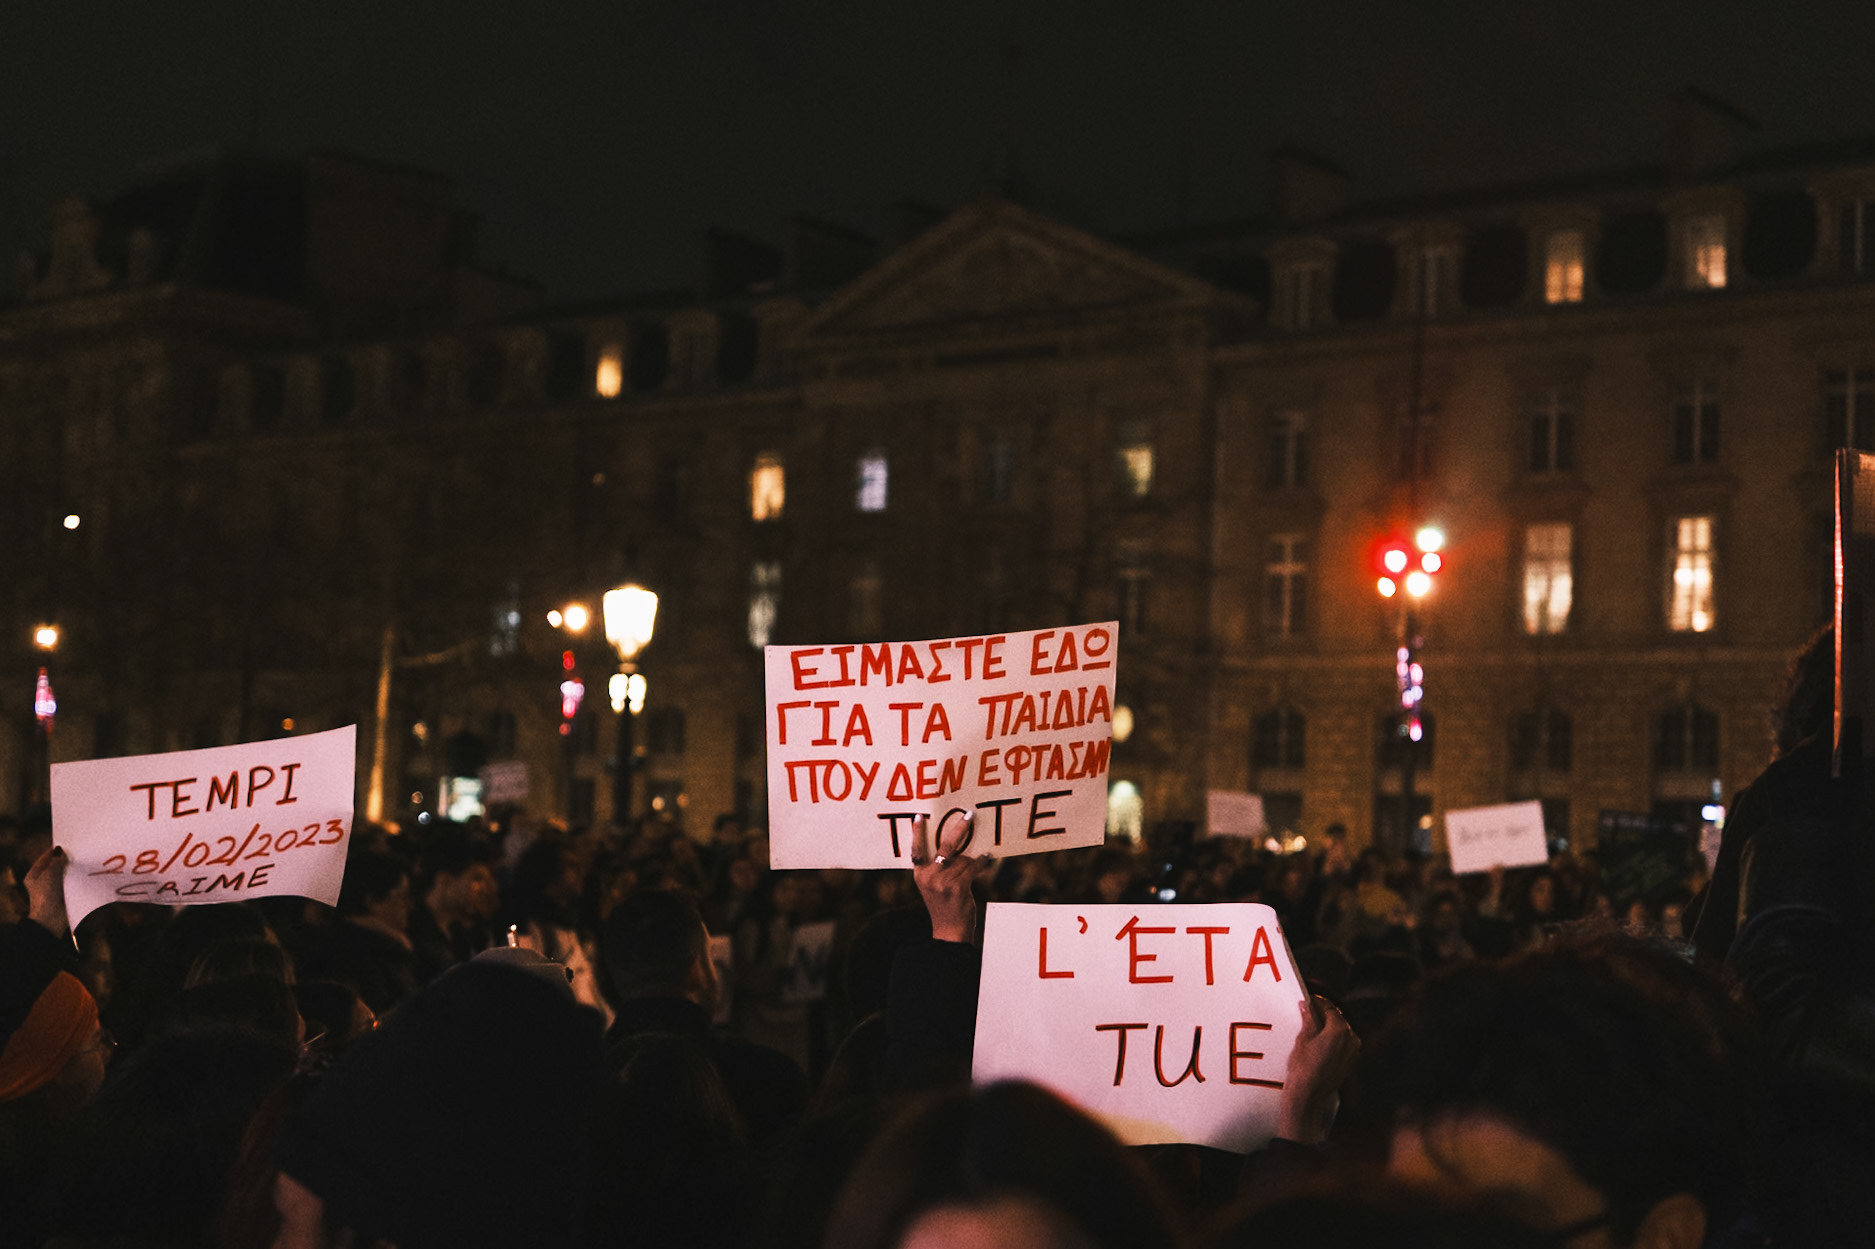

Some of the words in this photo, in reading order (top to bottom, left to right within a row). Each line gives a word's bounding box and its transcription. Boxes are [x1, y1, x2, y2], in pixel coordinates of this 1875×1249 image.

[790, 636, 1006, 690] ΕΙΜΑΣΤΕ
[1030, 628, 1111, 676] ΕΔΩ
[777, 701, 873, 747] ΓΙΑ
[889, 702, 952, 746] ΤΑ
[978, 685, 1112, 740] ΠΑΙΔΙΑ
[130, 763, 301, 820] TEMPI
[784, 759, 881, 803] ΠΟΥ
[886, 755, 968, 801] ΔΕΝ
[88, 818, 345, 877] 28/02/2023
[115, 863, 275, 896] CRIME
[1095, 1022, 1284, 1090] TUE
